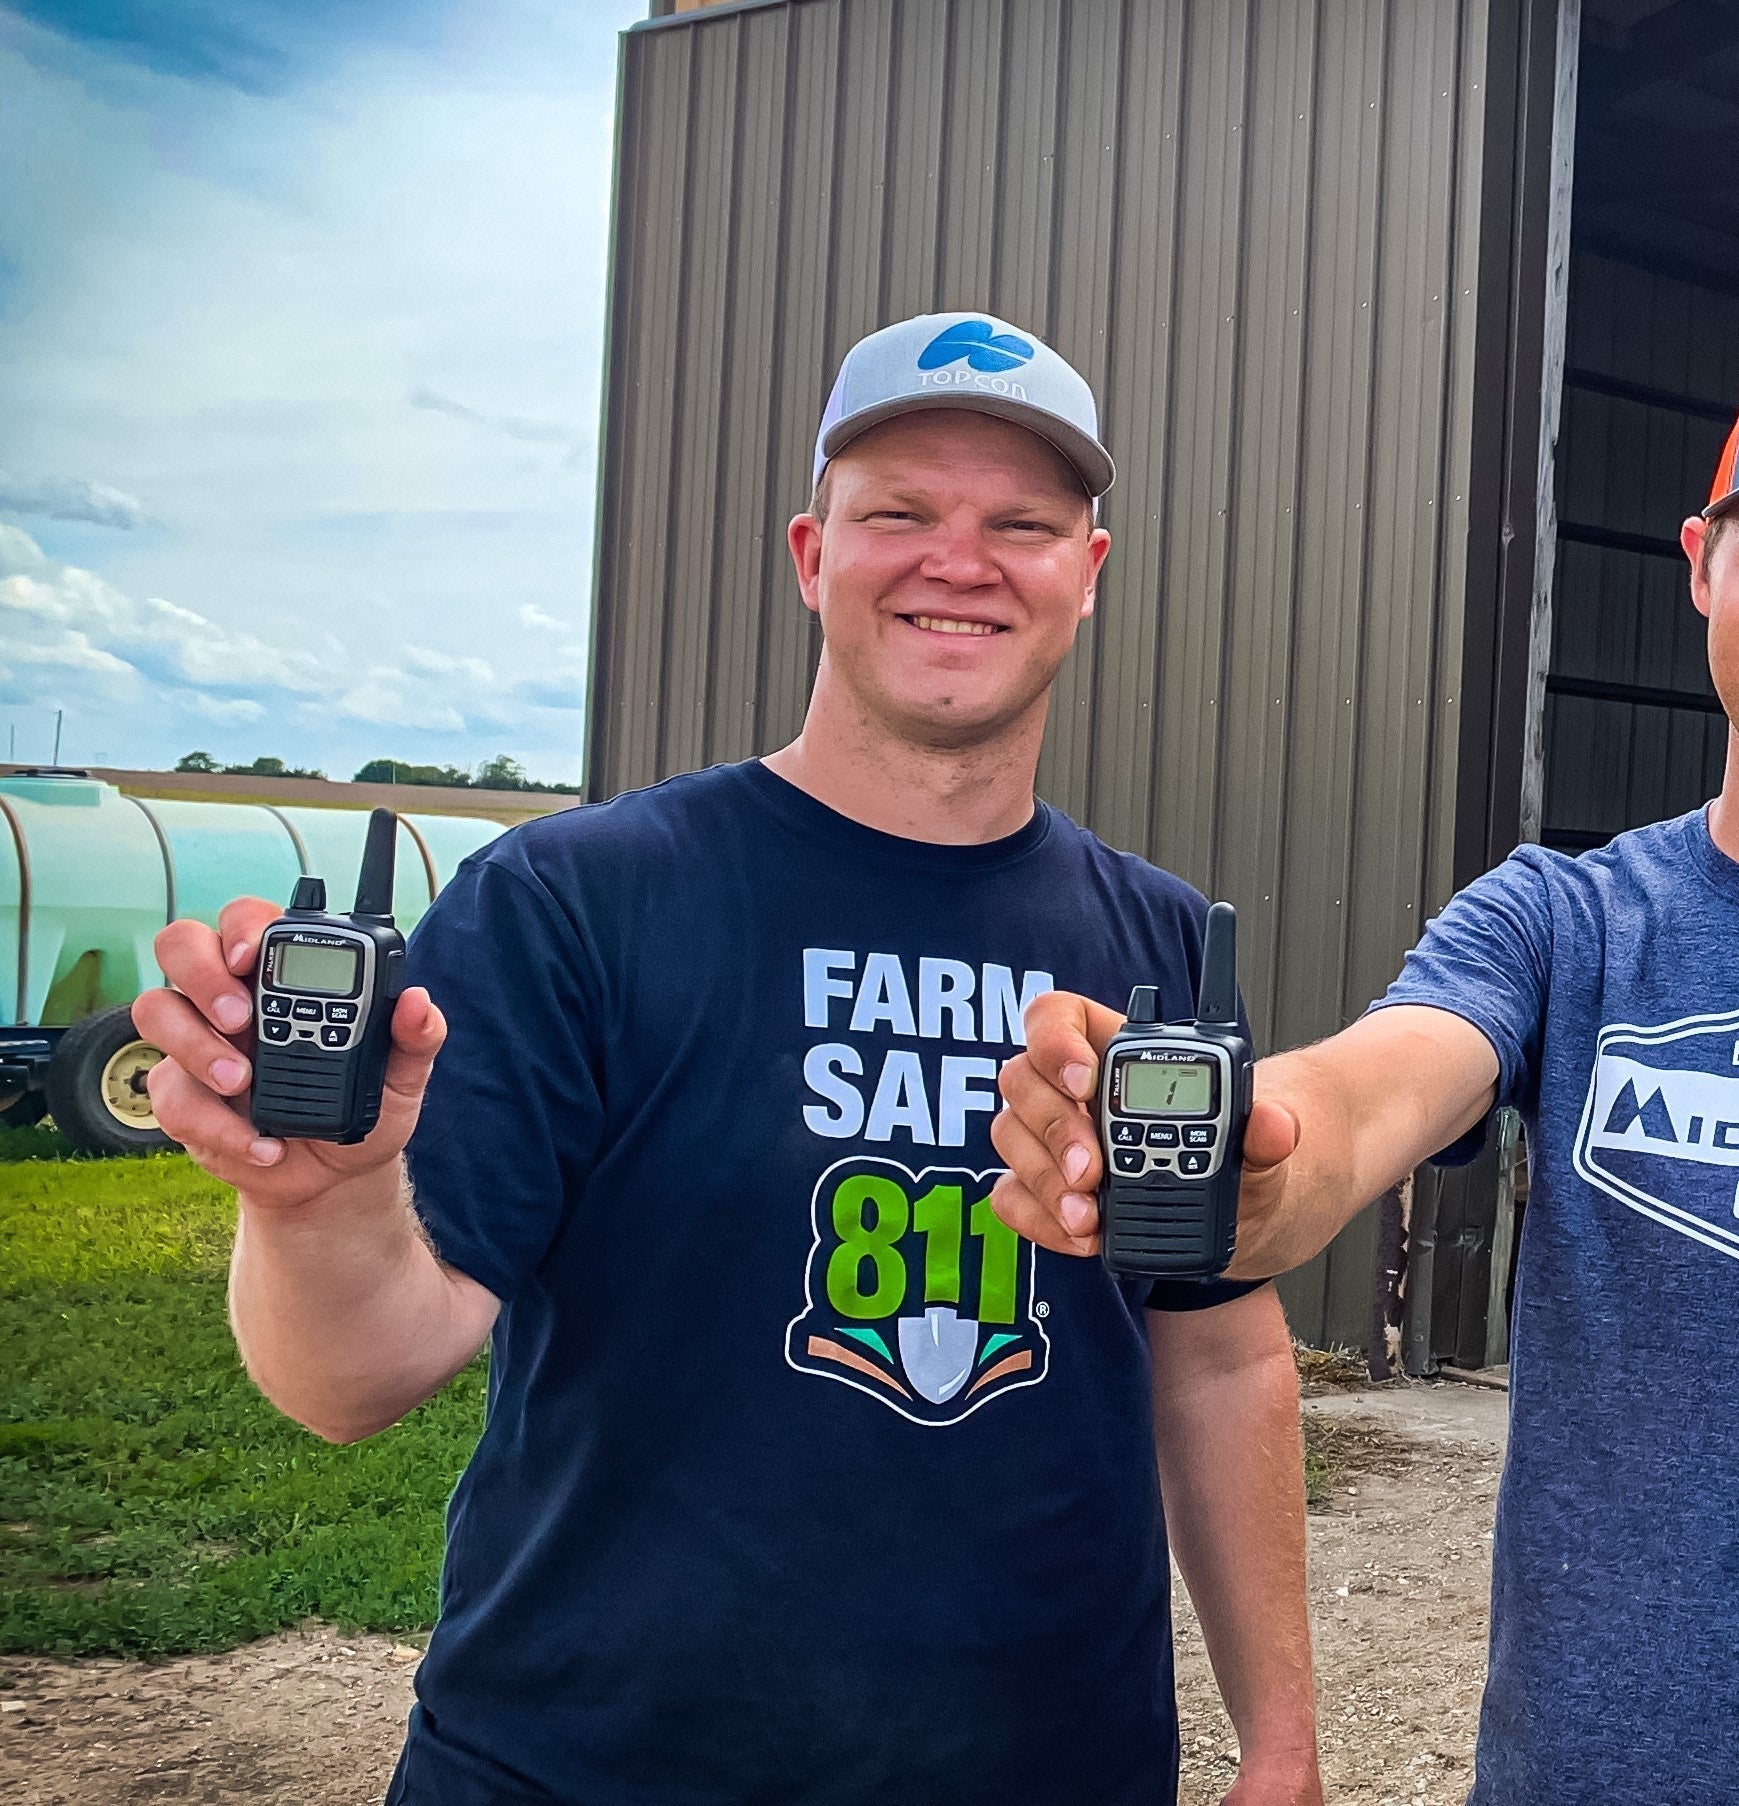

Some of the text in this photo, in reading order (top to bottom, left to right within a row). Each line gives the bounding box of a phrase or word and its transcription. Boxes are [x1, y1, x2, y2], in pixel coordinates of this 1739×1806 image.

[802, 1042, 1007, 1147] SAF
[1150, 1132, 1173, 1140] MENU
[826, 1174, 1019, 1325] 811
